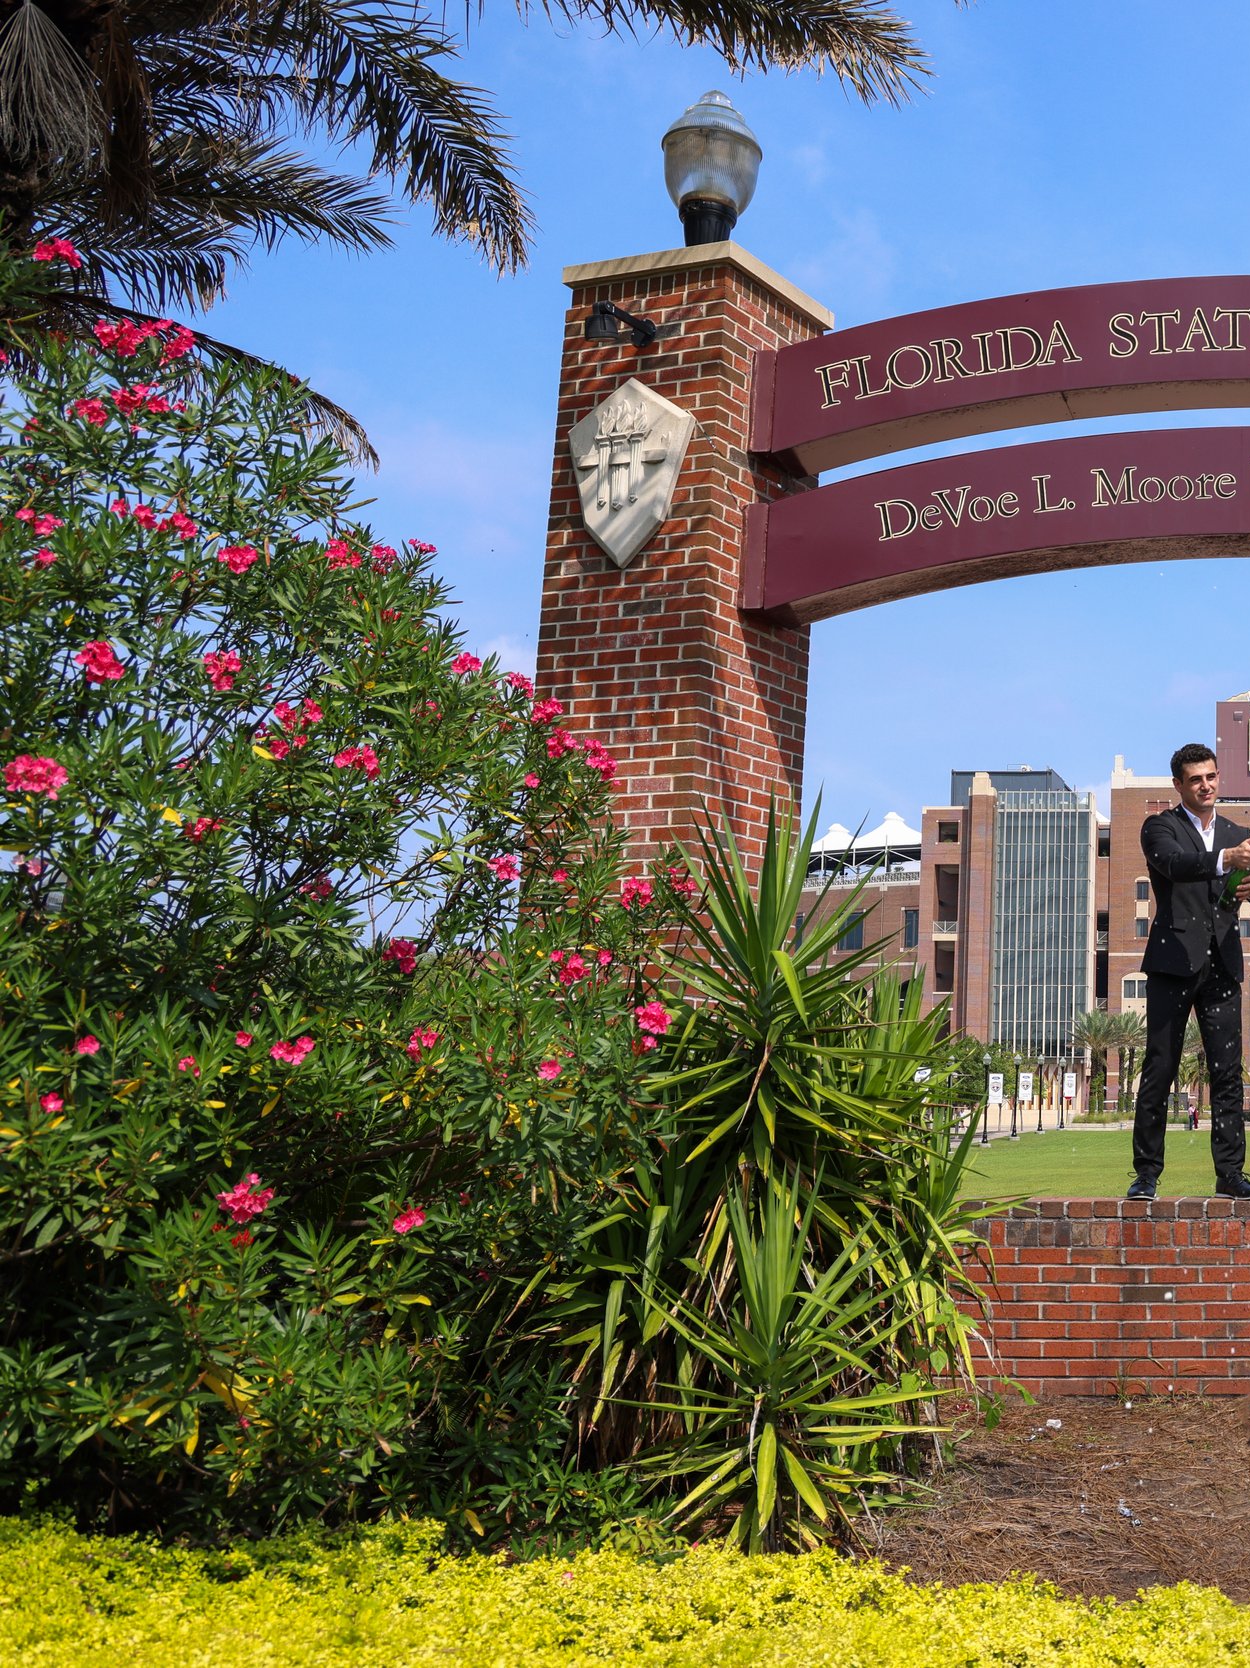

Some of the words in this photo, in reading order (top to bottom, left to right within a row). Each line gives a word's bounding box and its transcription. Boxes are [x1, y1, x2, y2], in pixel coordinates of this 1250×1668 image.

[814, 319, 1083, 410] FLORIDA
[873, 484, 1021, 542] DeVoe
[1031, 474, 1077, 514] L.
[1090, 465, 1238, 508] Moore
